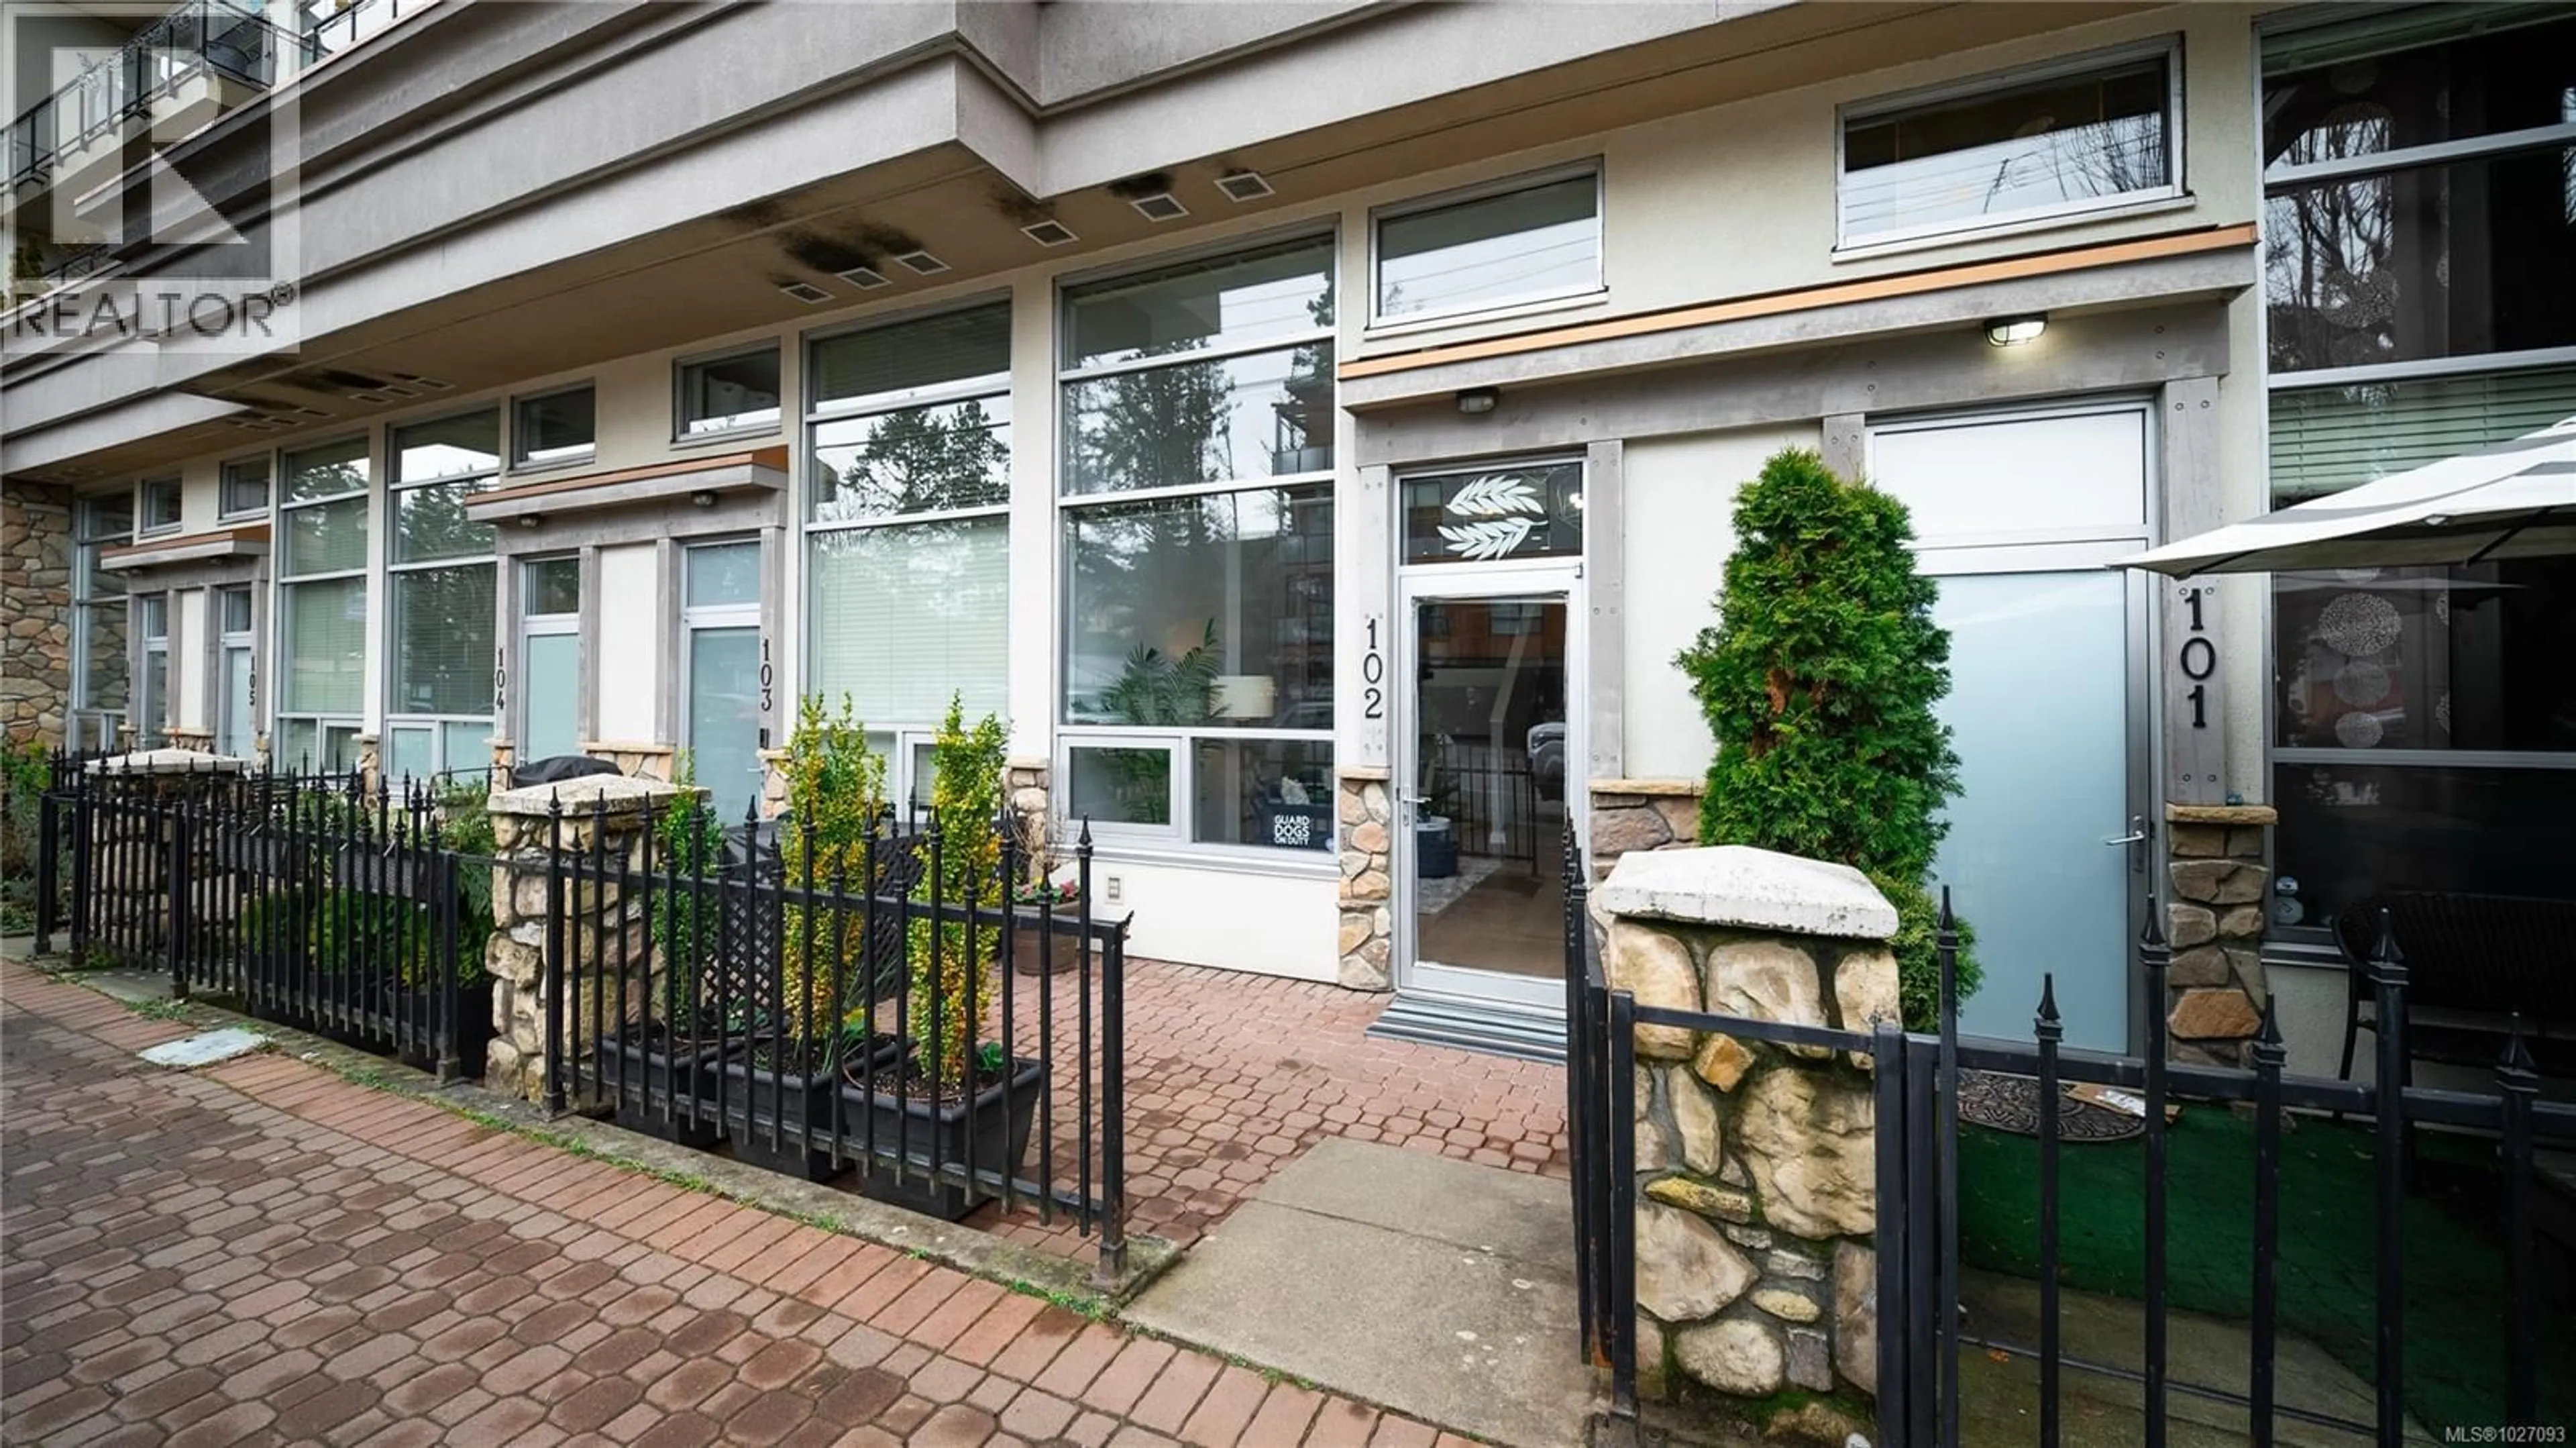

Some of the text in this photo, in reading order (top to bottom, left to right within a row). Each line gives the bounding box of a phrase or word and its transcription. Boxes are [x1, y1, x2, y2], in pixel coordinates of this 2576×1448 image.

[496, 648, 505, 710] 104
[761, 639, 772, 711] 103
[1364, 619, 1383, 719] 102
[2181, 588, 2216, 729] 101
[1275, 815, 1310, 825] GUARD
[1275, 825, 1310, 837] DOGS
[1288, 837, 1309, 845] DUTY
